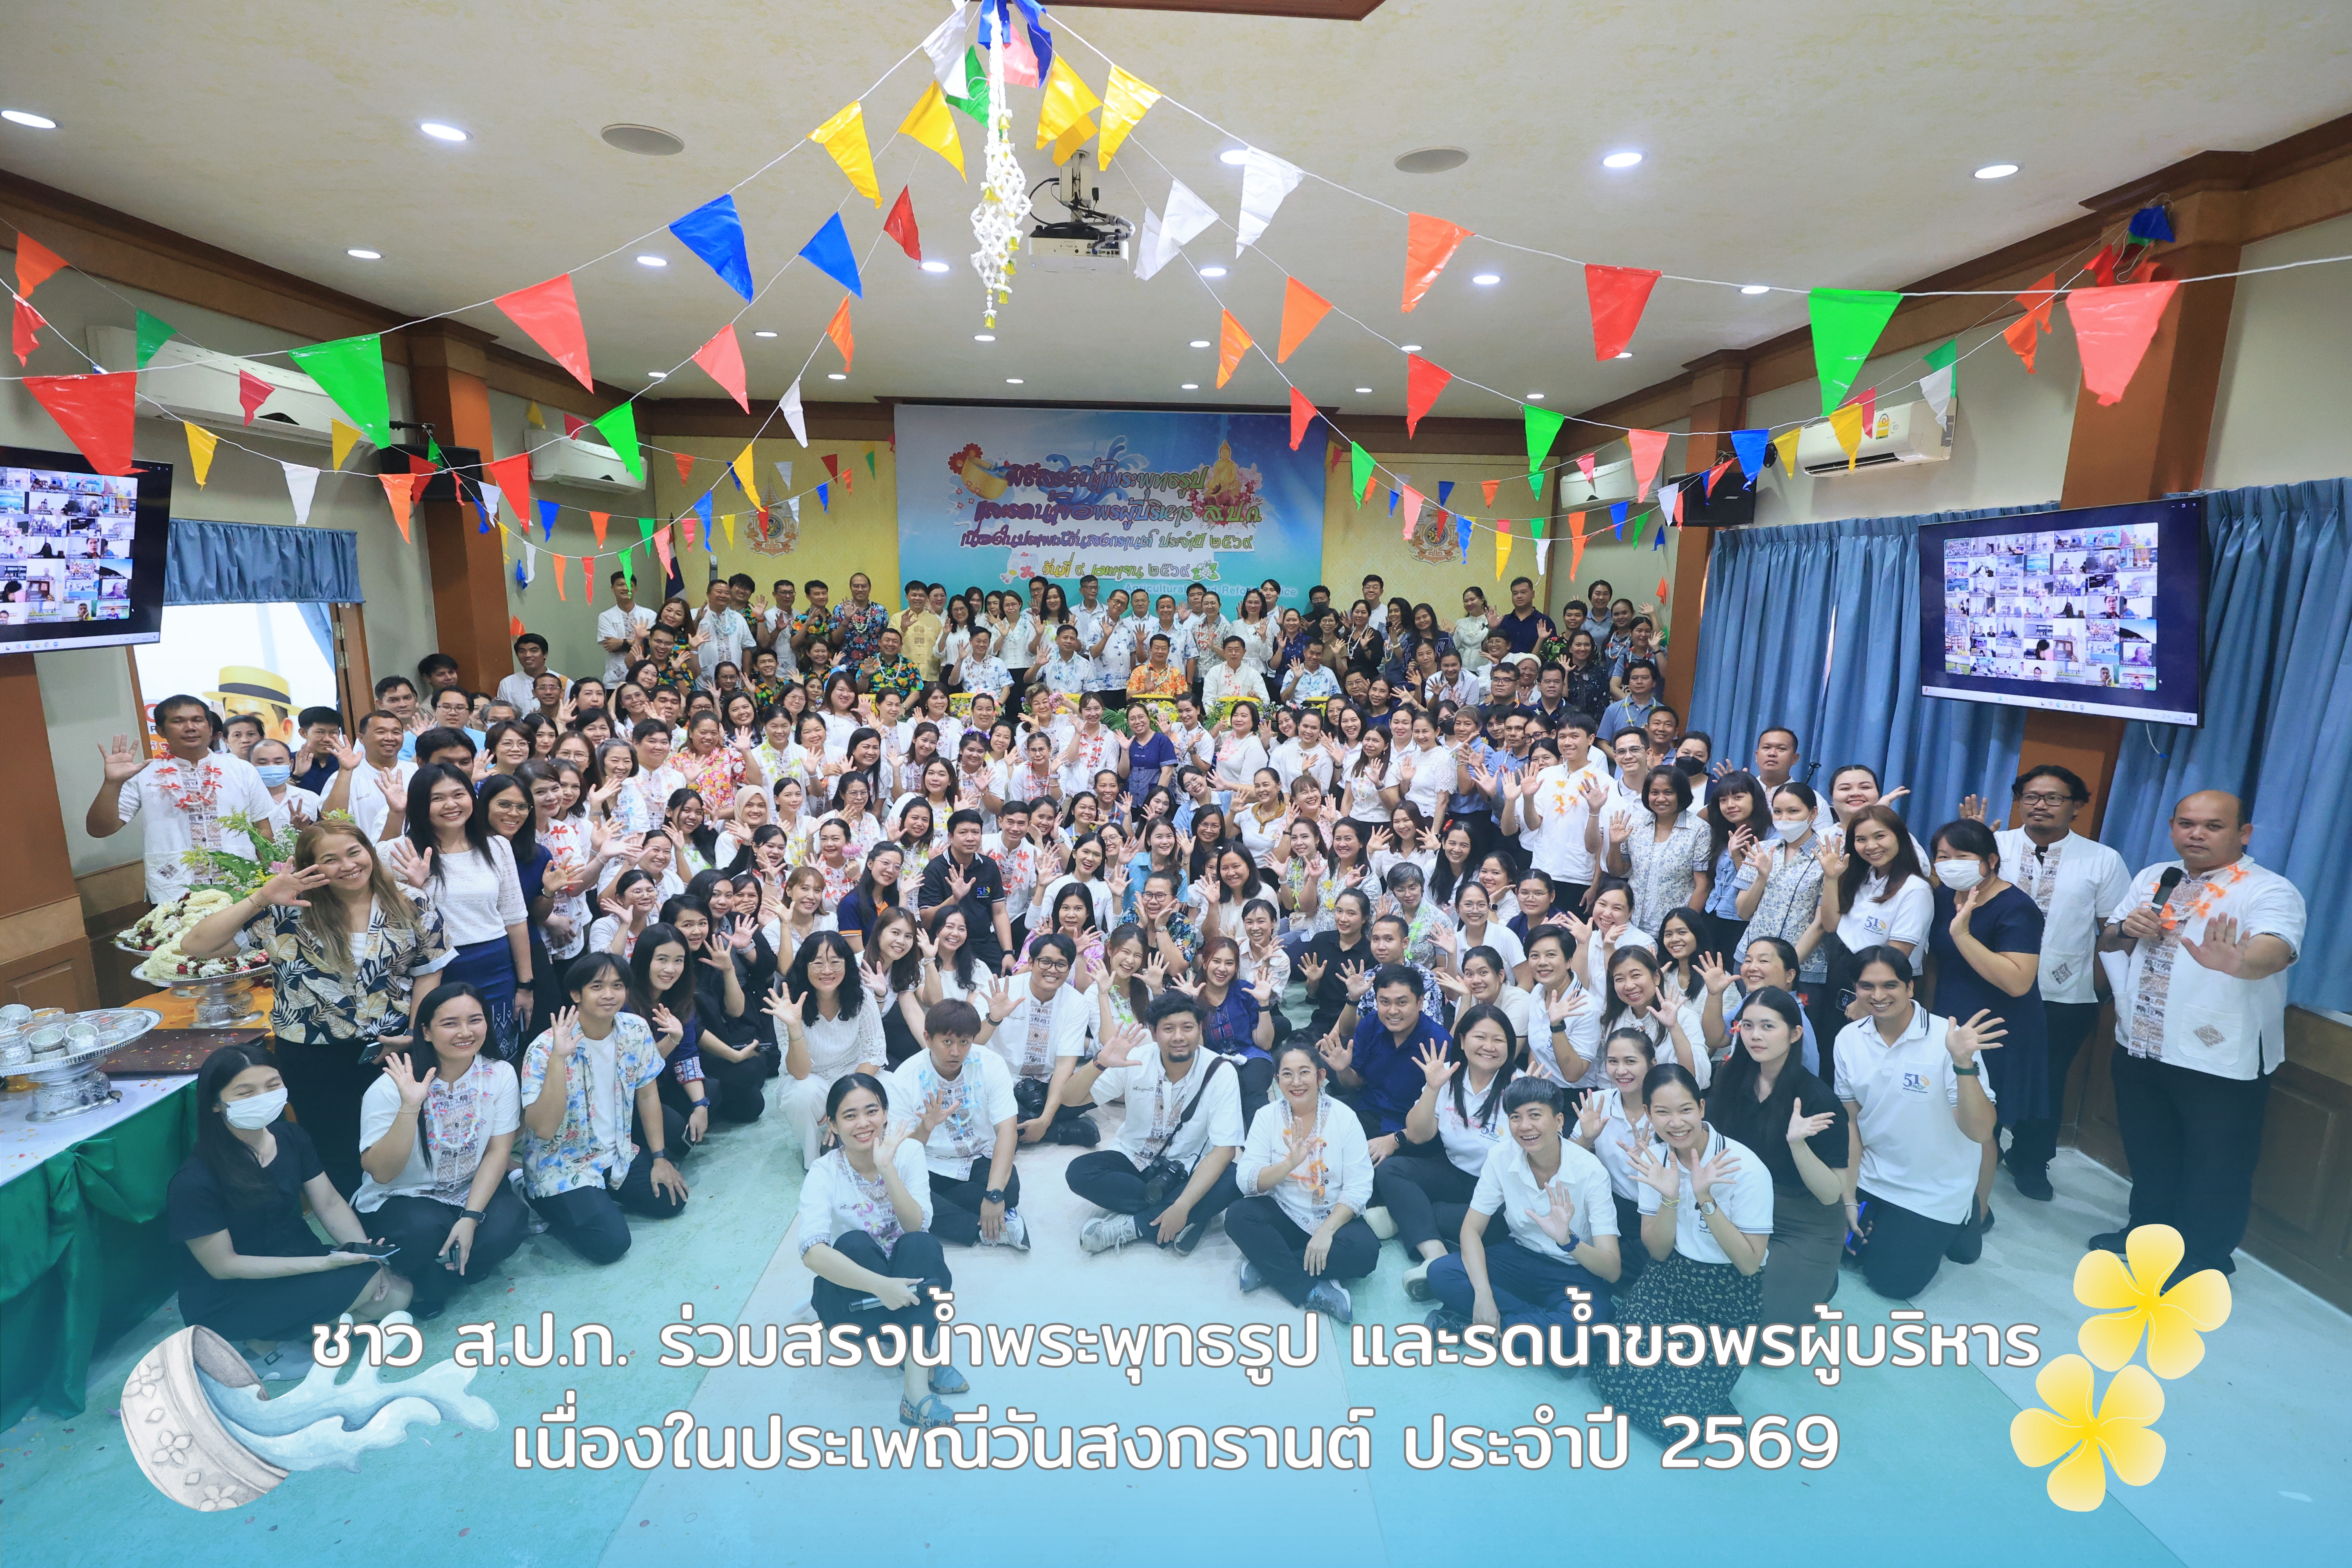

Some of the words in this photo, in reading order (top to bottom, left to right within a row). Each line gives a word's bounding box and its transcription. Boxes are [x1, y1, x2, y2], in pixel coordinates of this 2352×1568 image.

[1159, 530, 1207, 551] ประจำปี
[1209, 535, 1253, 549] ๒๕๖๙
[1042, 552, 1075, 577] วันที่
[1075, 563, 1085, 576] ๙
[1091, 564, 1144, 579] เมษายน
[1148, 563, 1190, 577] ๒๕๖๙
[1865, 916, 1878, 927] 51
[1903, 1073, 1920, 1087] 51
